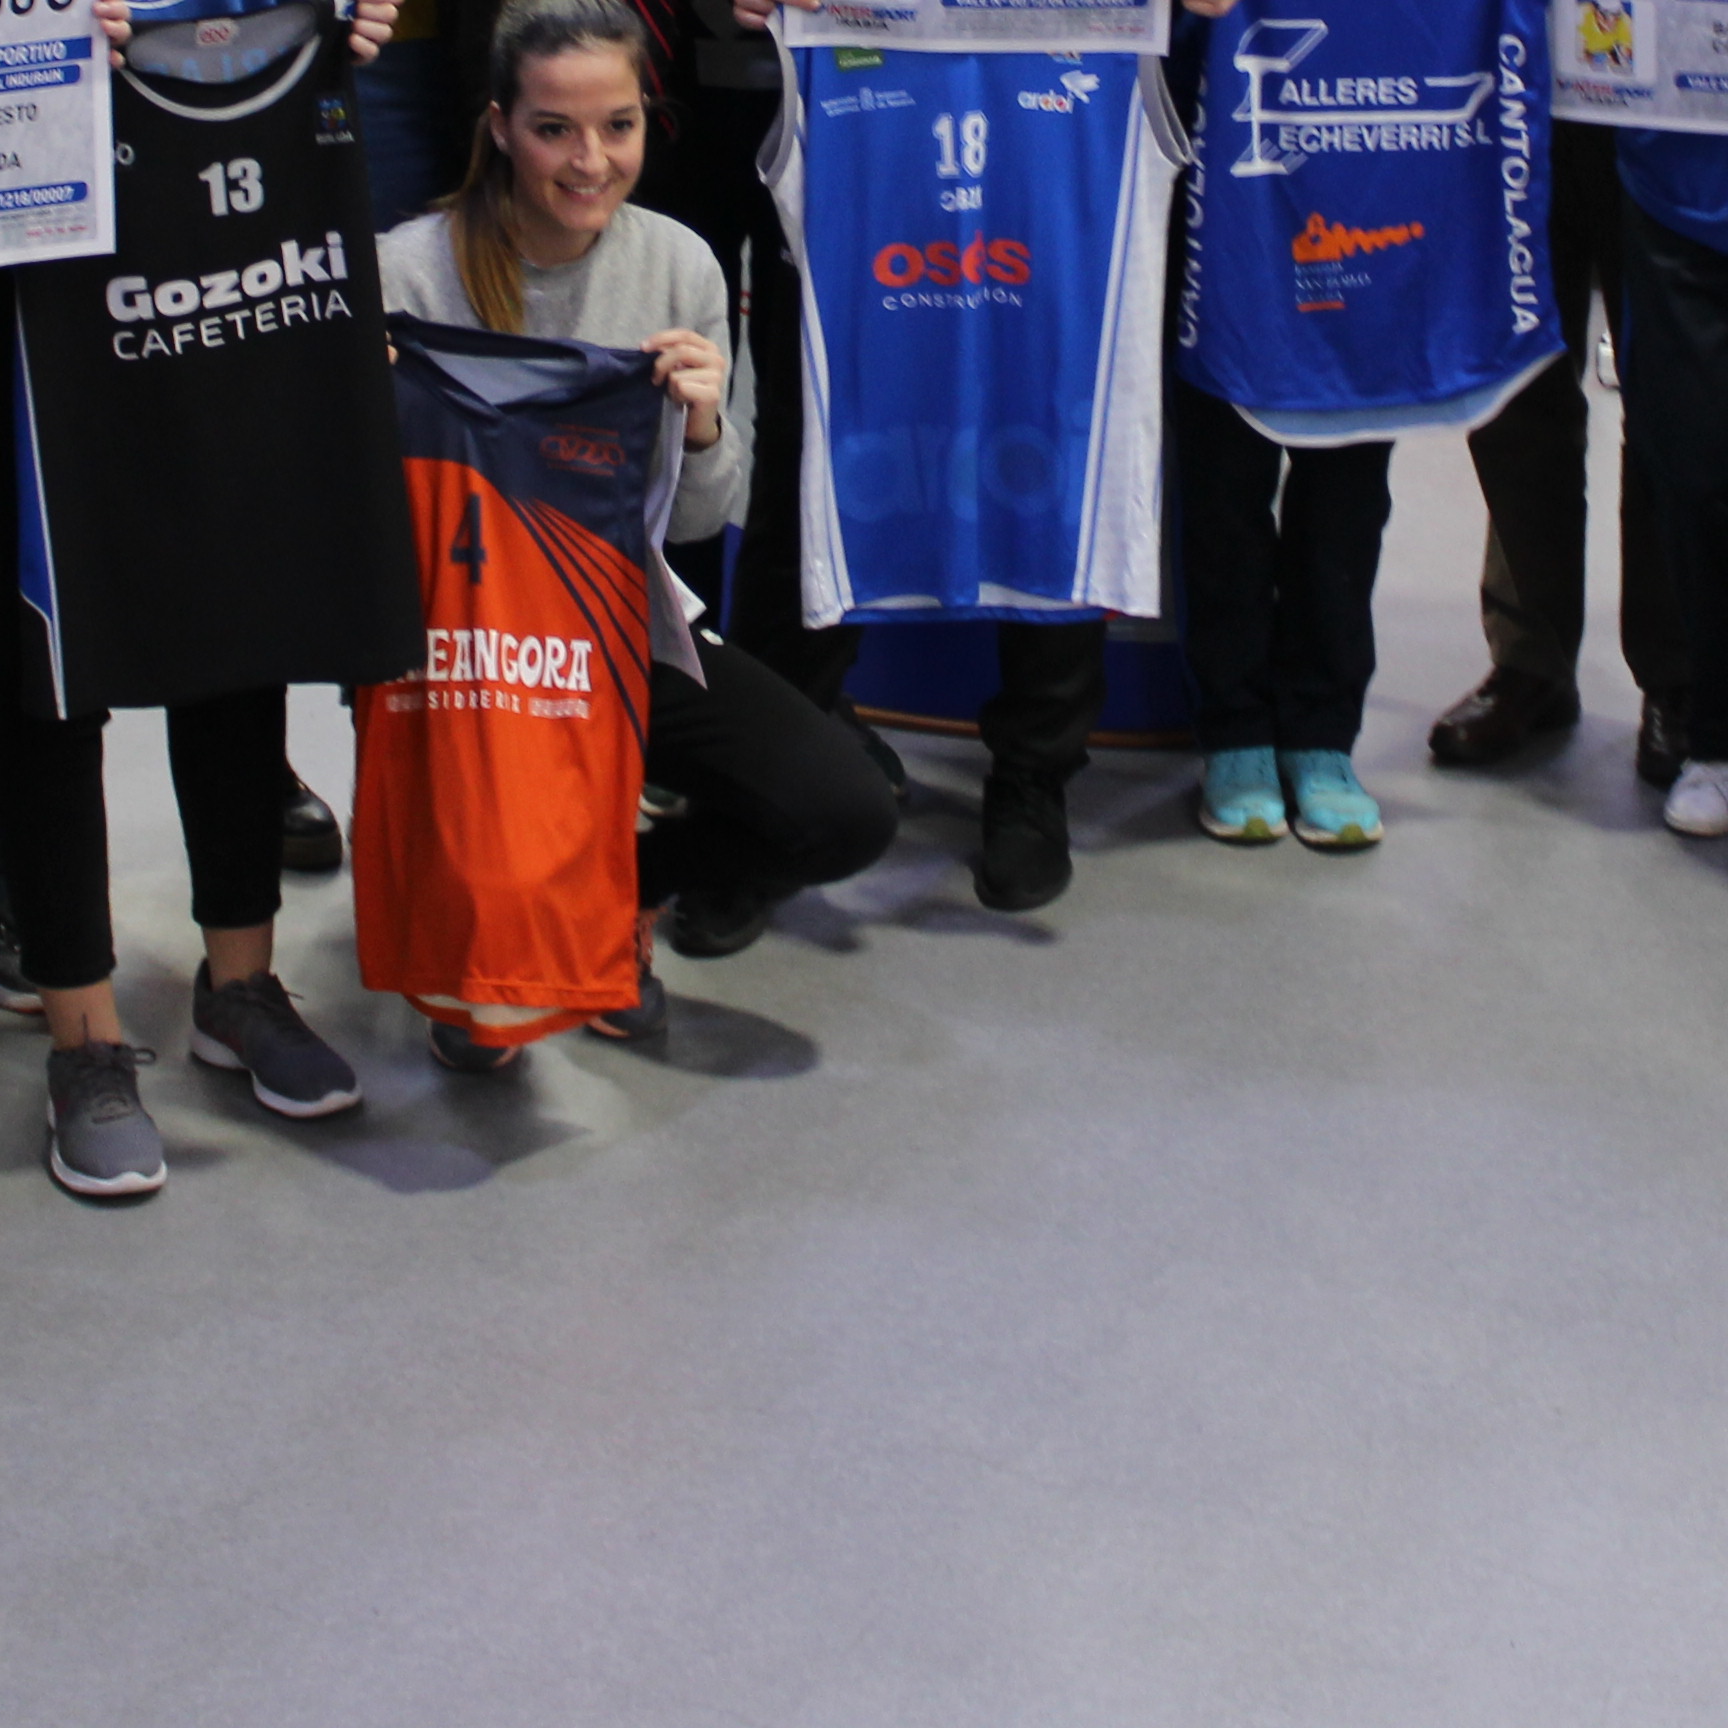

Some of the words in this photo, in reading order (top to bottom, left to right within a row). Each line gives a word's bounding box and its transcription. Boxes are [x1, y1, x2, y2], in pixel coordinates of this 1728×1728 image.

[6, 68, 65, 90] INDURAIN
[932, 110, 990, 179] 18
[1279, 124, 1450, 153] ECHEVERRI
[198, 156, 265, 217] 13
[1498, 32, 1540, 335] CANTOLAGUA
[105, 230, 349, 323] Gozoki
[112, 289, 353, 361] CAFETERIA
[449, 491, 487, 586] 4
